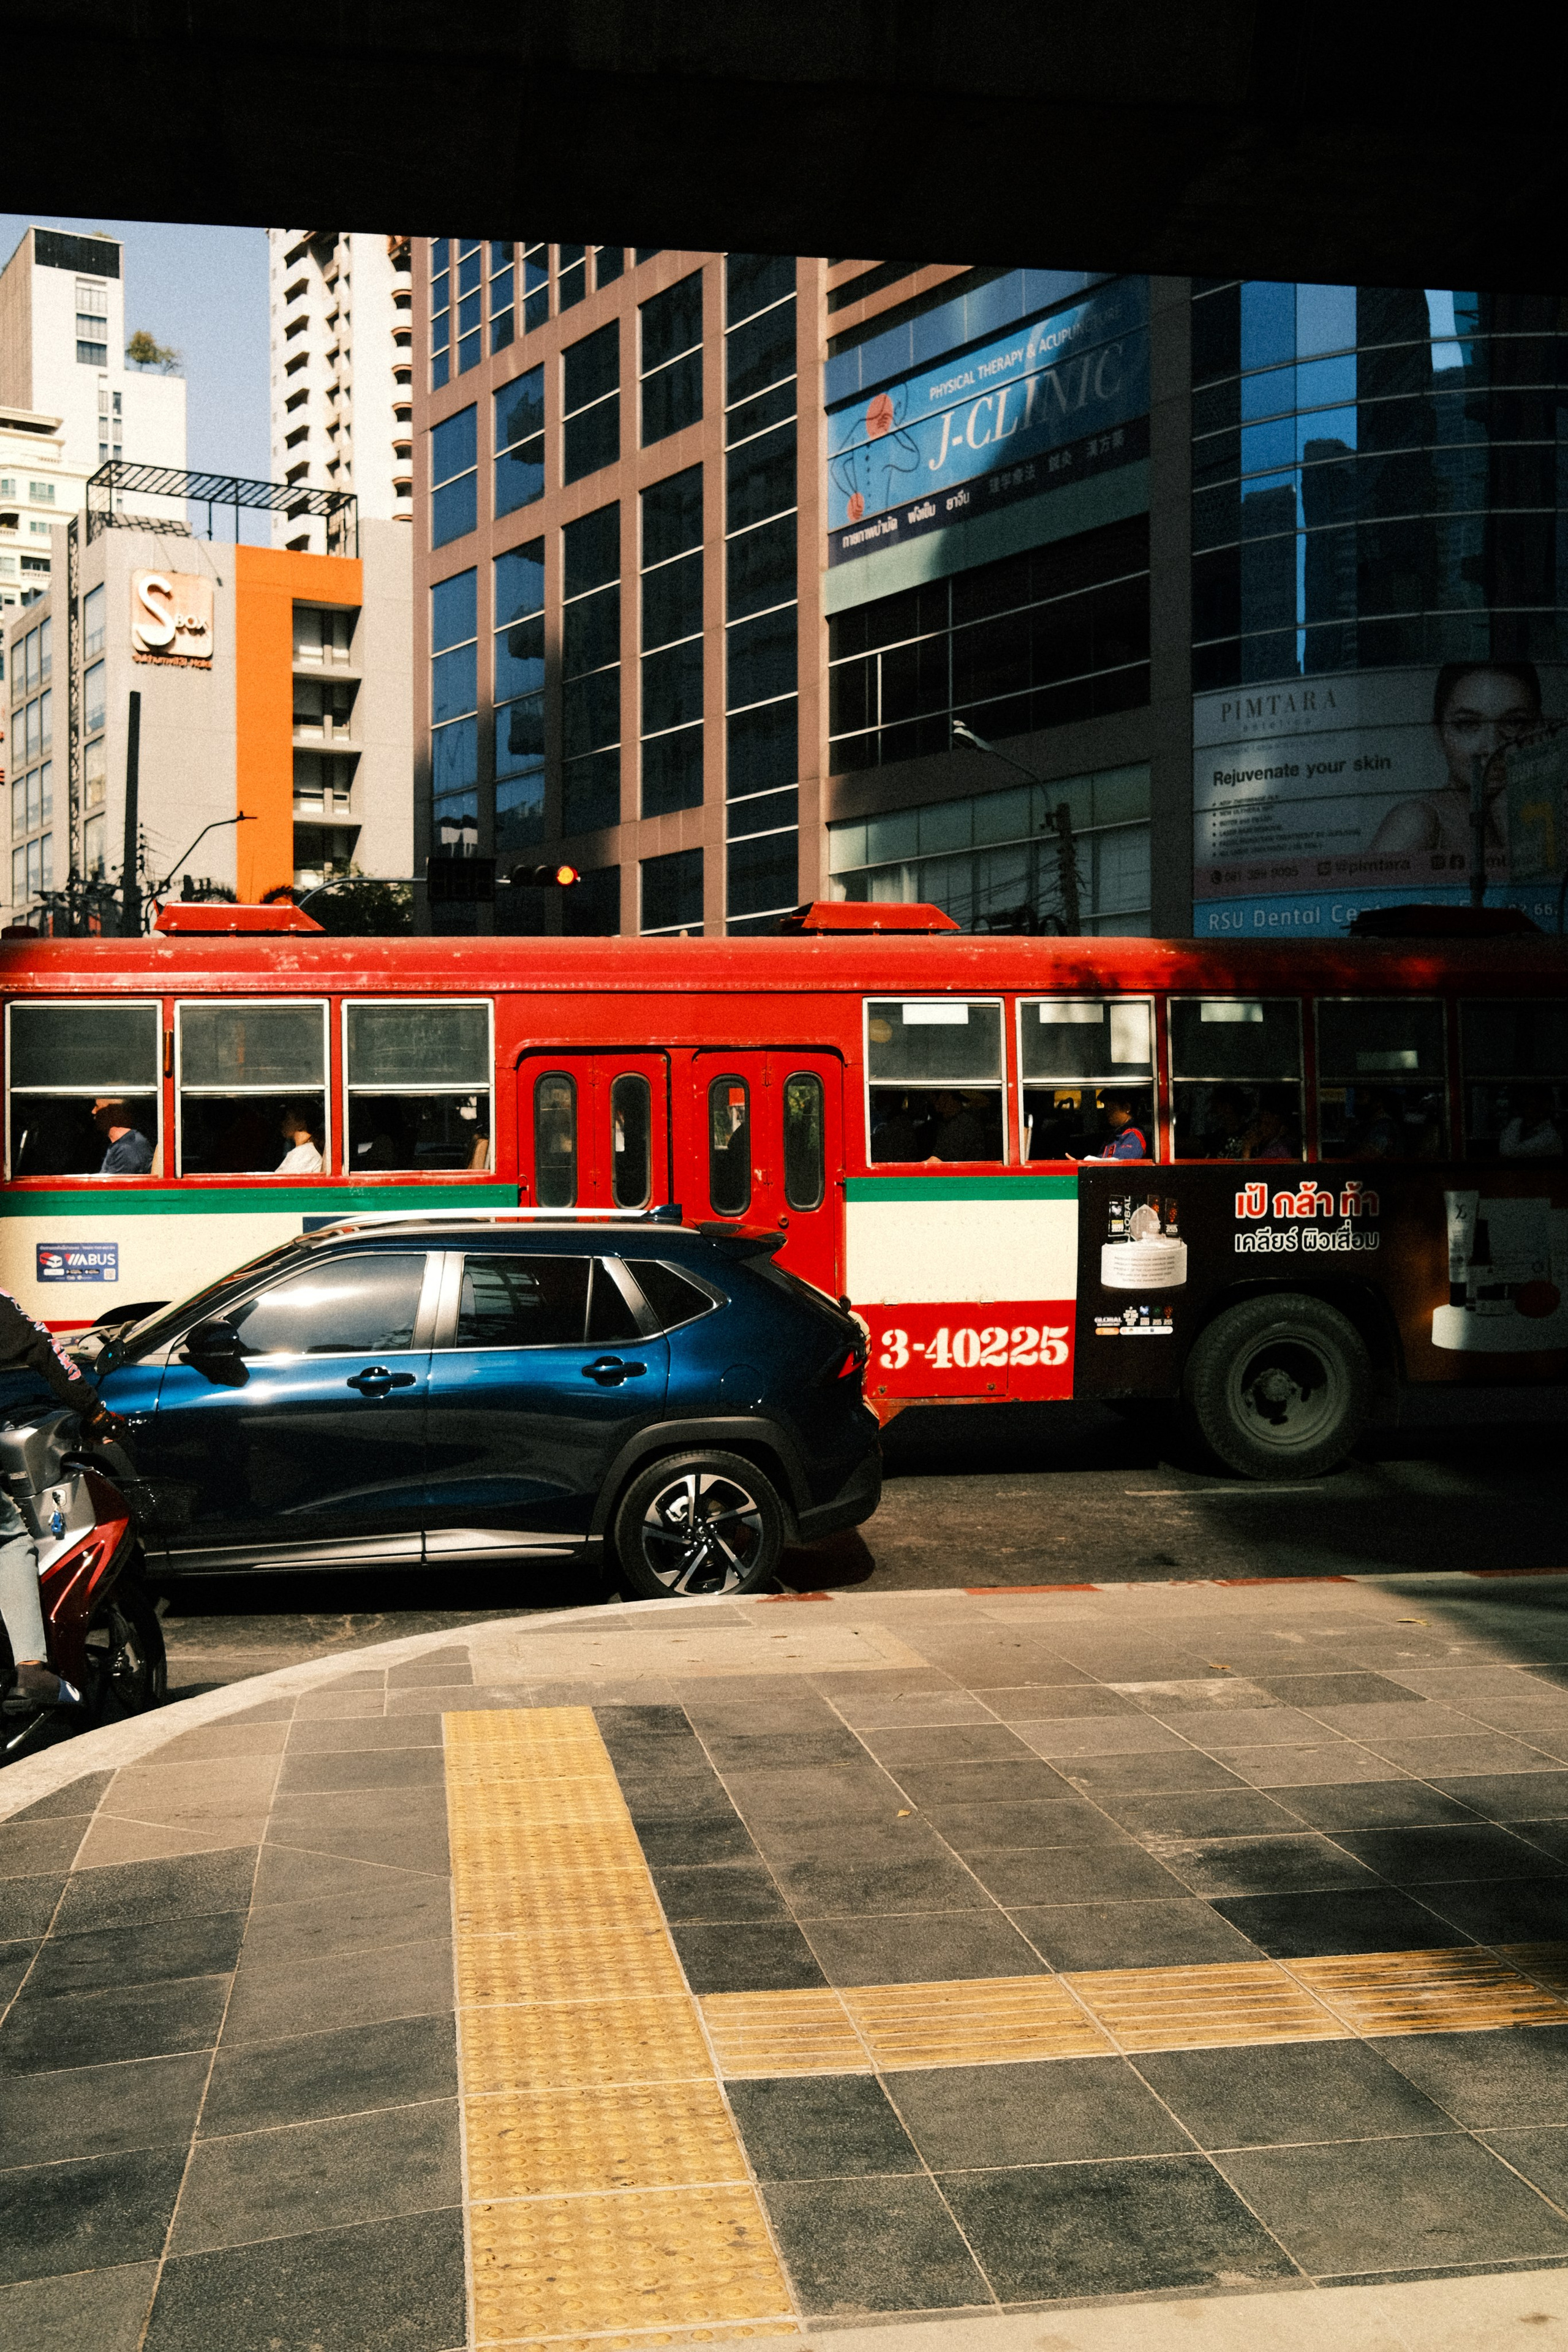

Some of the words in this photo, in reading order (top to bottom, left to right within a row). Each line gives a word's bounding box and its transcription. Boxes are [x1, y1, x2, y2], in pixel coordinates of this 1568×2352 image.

[929, 372, 976, 401] PHYSICAL
[978, 348, 1025, 382] THERAPY
[1026, 343, 1037, 359] &
[928, 342, 1125, 472] J-CLINIC
[137, 575, 175, 646] S
[175, 613, 208, 631] BOX
[1221, 688, 1338, 723] PIMTARA
[1212, 764, 1300, 787] Rejuvenate
[1305, 760, 1346, 778] your
[1352, 755, 1393, 772] skin
[1208, 909, 1243, 930] RSU
[1253, 906, 1321, 928] Dental
[1273, 1181, 1333, 1218] กล้า
[1235, 1226, 1298, 1253] เคลียร์
[1302, 1219, 1379, 1251] ผิวเสื่อม
[880, 1325, 1069, 1370] 3-40225
